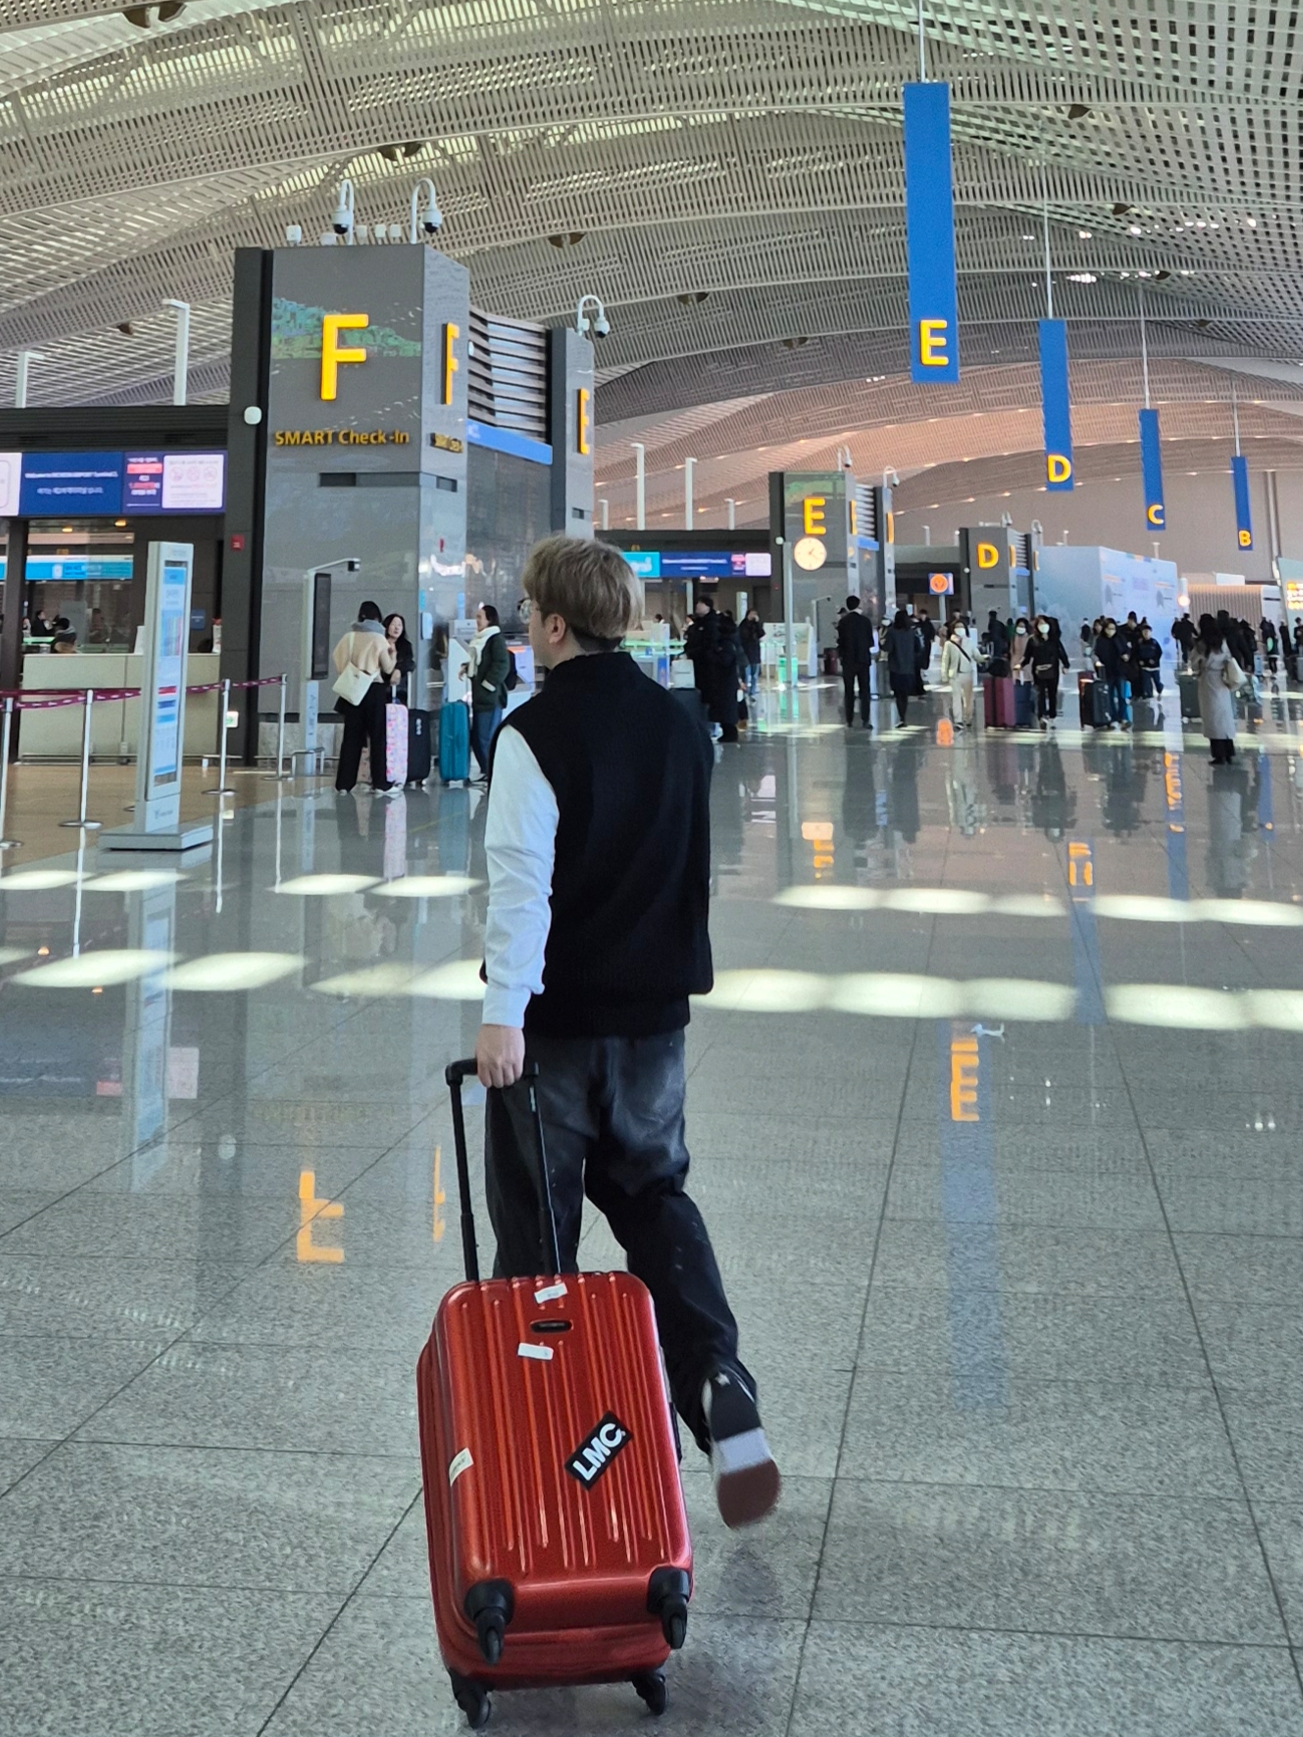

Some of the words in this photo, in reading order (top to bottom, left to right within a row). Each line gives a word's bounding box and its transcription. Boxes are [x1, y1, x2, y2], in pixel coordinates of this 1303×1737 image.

[321, 313, 369, 400] F
[919, 320, 949, 366] E
[274, 430, 334, 446] SMART
[1046, 454, 1072, 483] D
[803, 496, 827, 535] E
[1147, 504, 1165, 525] C
[1238, 530, 1252, 547] B
[977, 541, 999, 569] D
